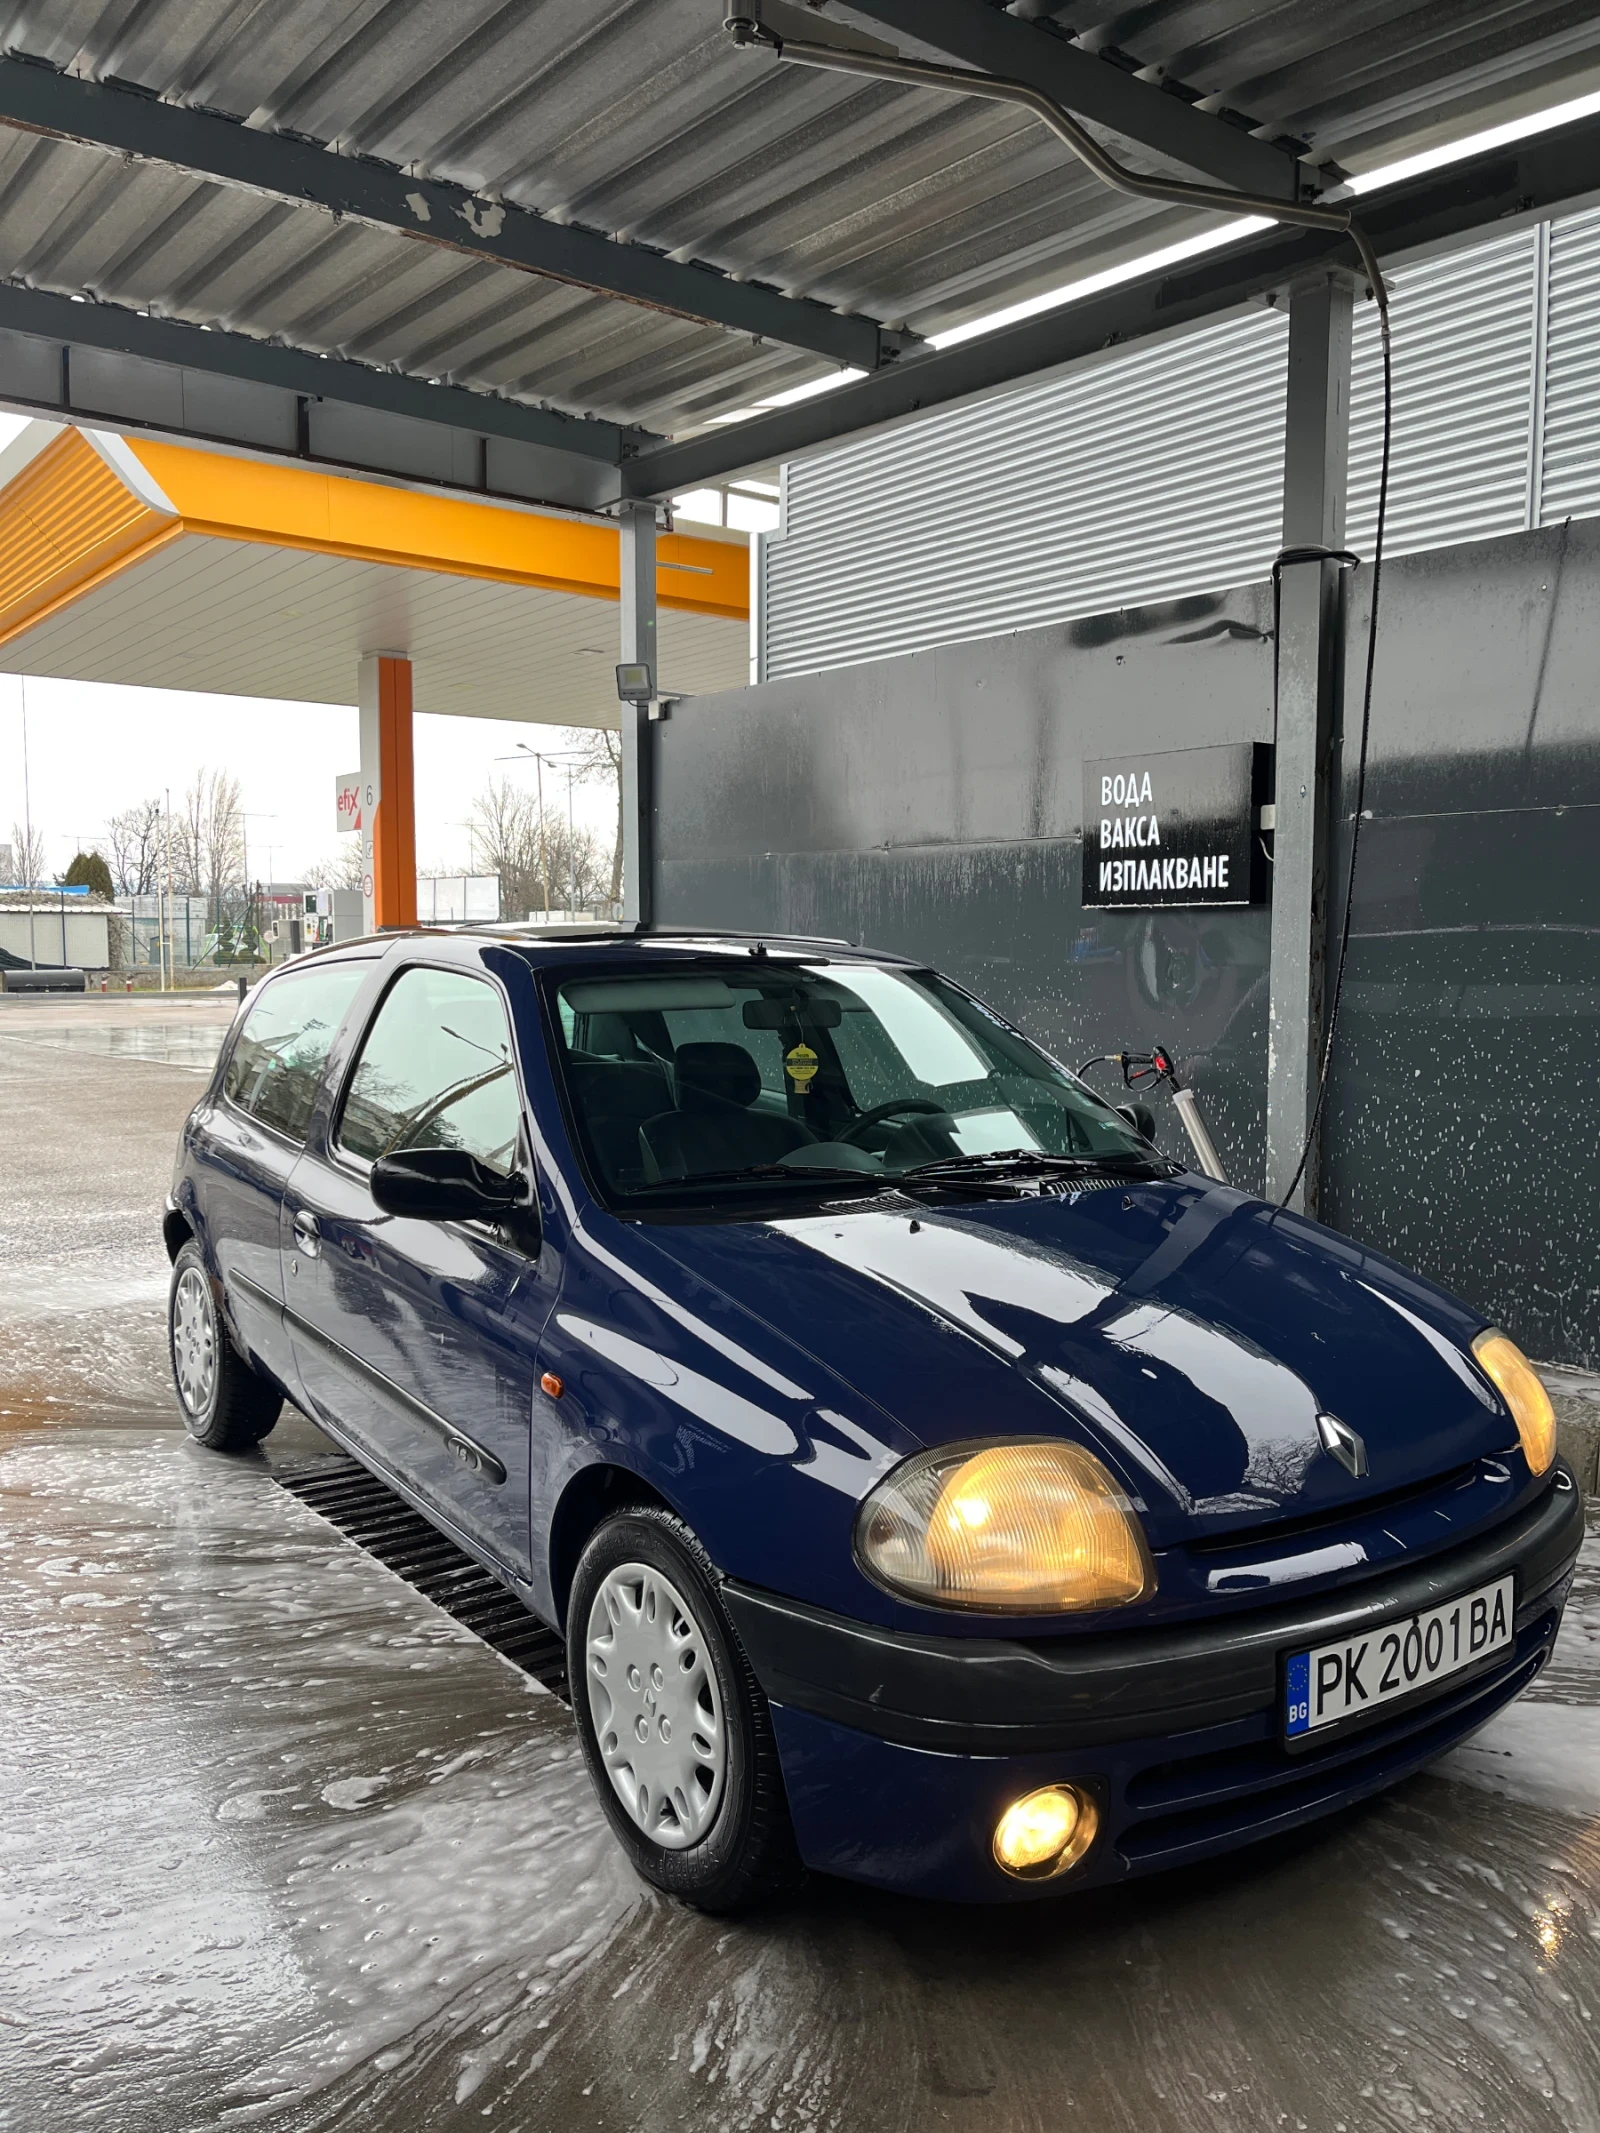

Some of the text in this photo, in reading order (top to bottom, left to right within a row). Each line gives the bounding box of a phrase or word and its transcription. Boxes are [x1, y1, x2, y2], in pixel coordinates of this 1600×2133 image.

[337, 787, 360, 816] efix
[366, 784, 373, 806] 6
[1101, 772, 1153, 808] ВОДА
[1100, 815, 1161, 849] ВАКСА
[1099, 854, 1230, 892] ИЗПЛАКВАНЕ
[1289, 1702, 1307, 1724] BG
